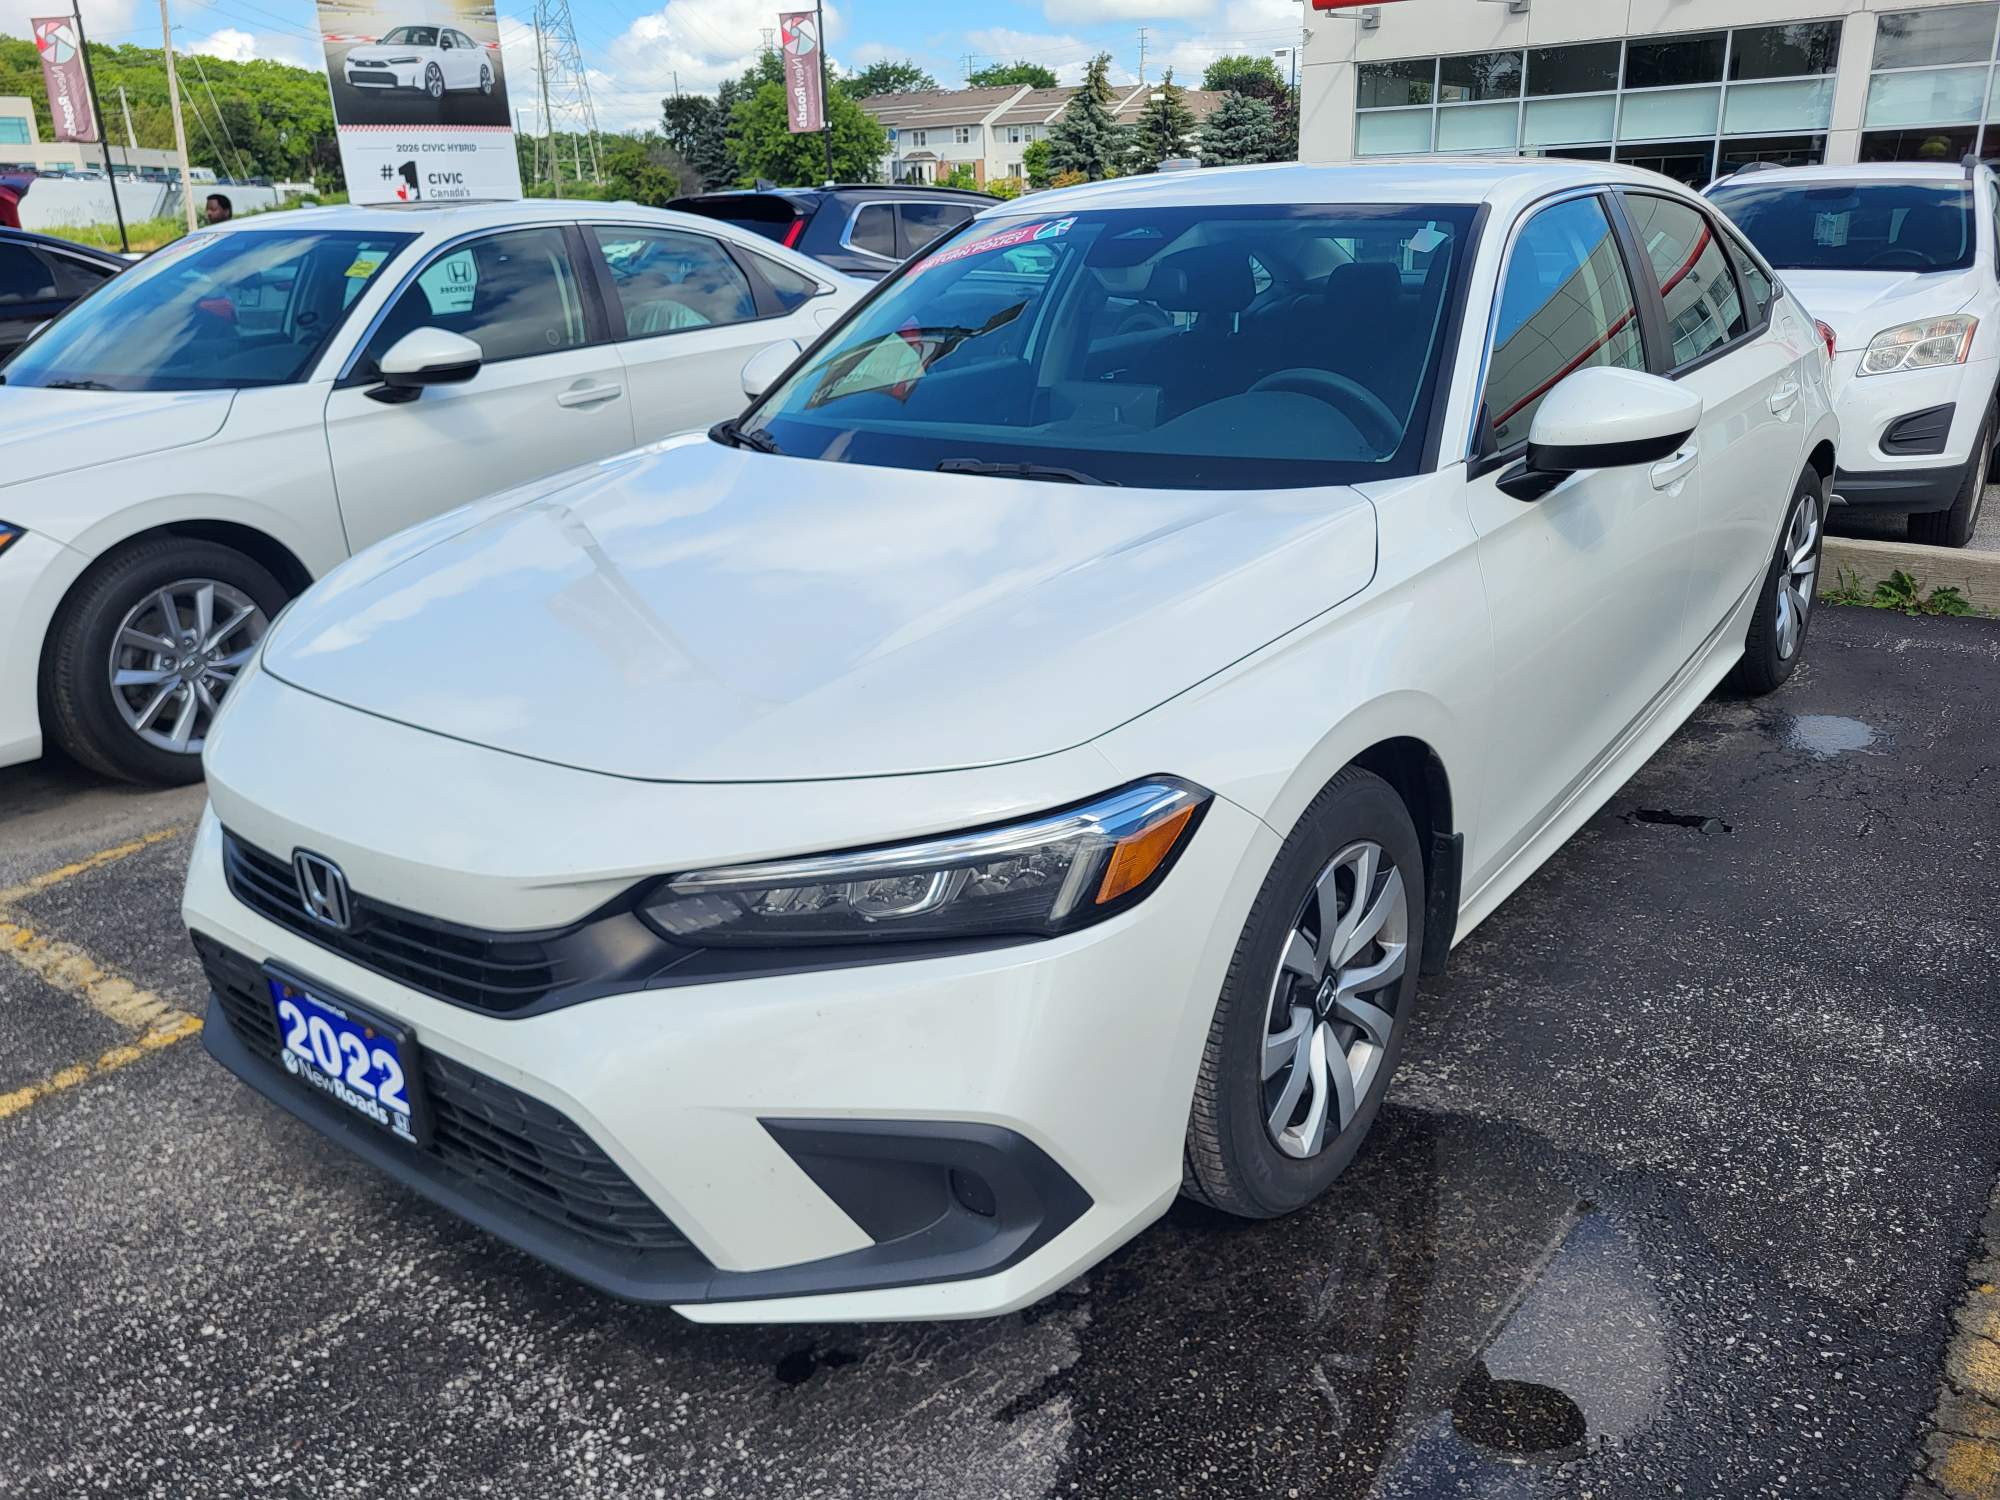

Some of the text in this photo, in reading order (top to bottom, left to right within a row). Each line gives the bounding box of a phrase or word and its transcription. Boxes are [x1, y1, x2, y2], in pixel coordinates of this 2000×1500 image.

[421, 143, 446, 152] CIVIC
[428, 173, 464, 185] CIVIC
[430, 187, 471, 198] Canada's
[278, 999, 411, 1116] 2022
[298, 1058, 389, 1125] NewRoads
